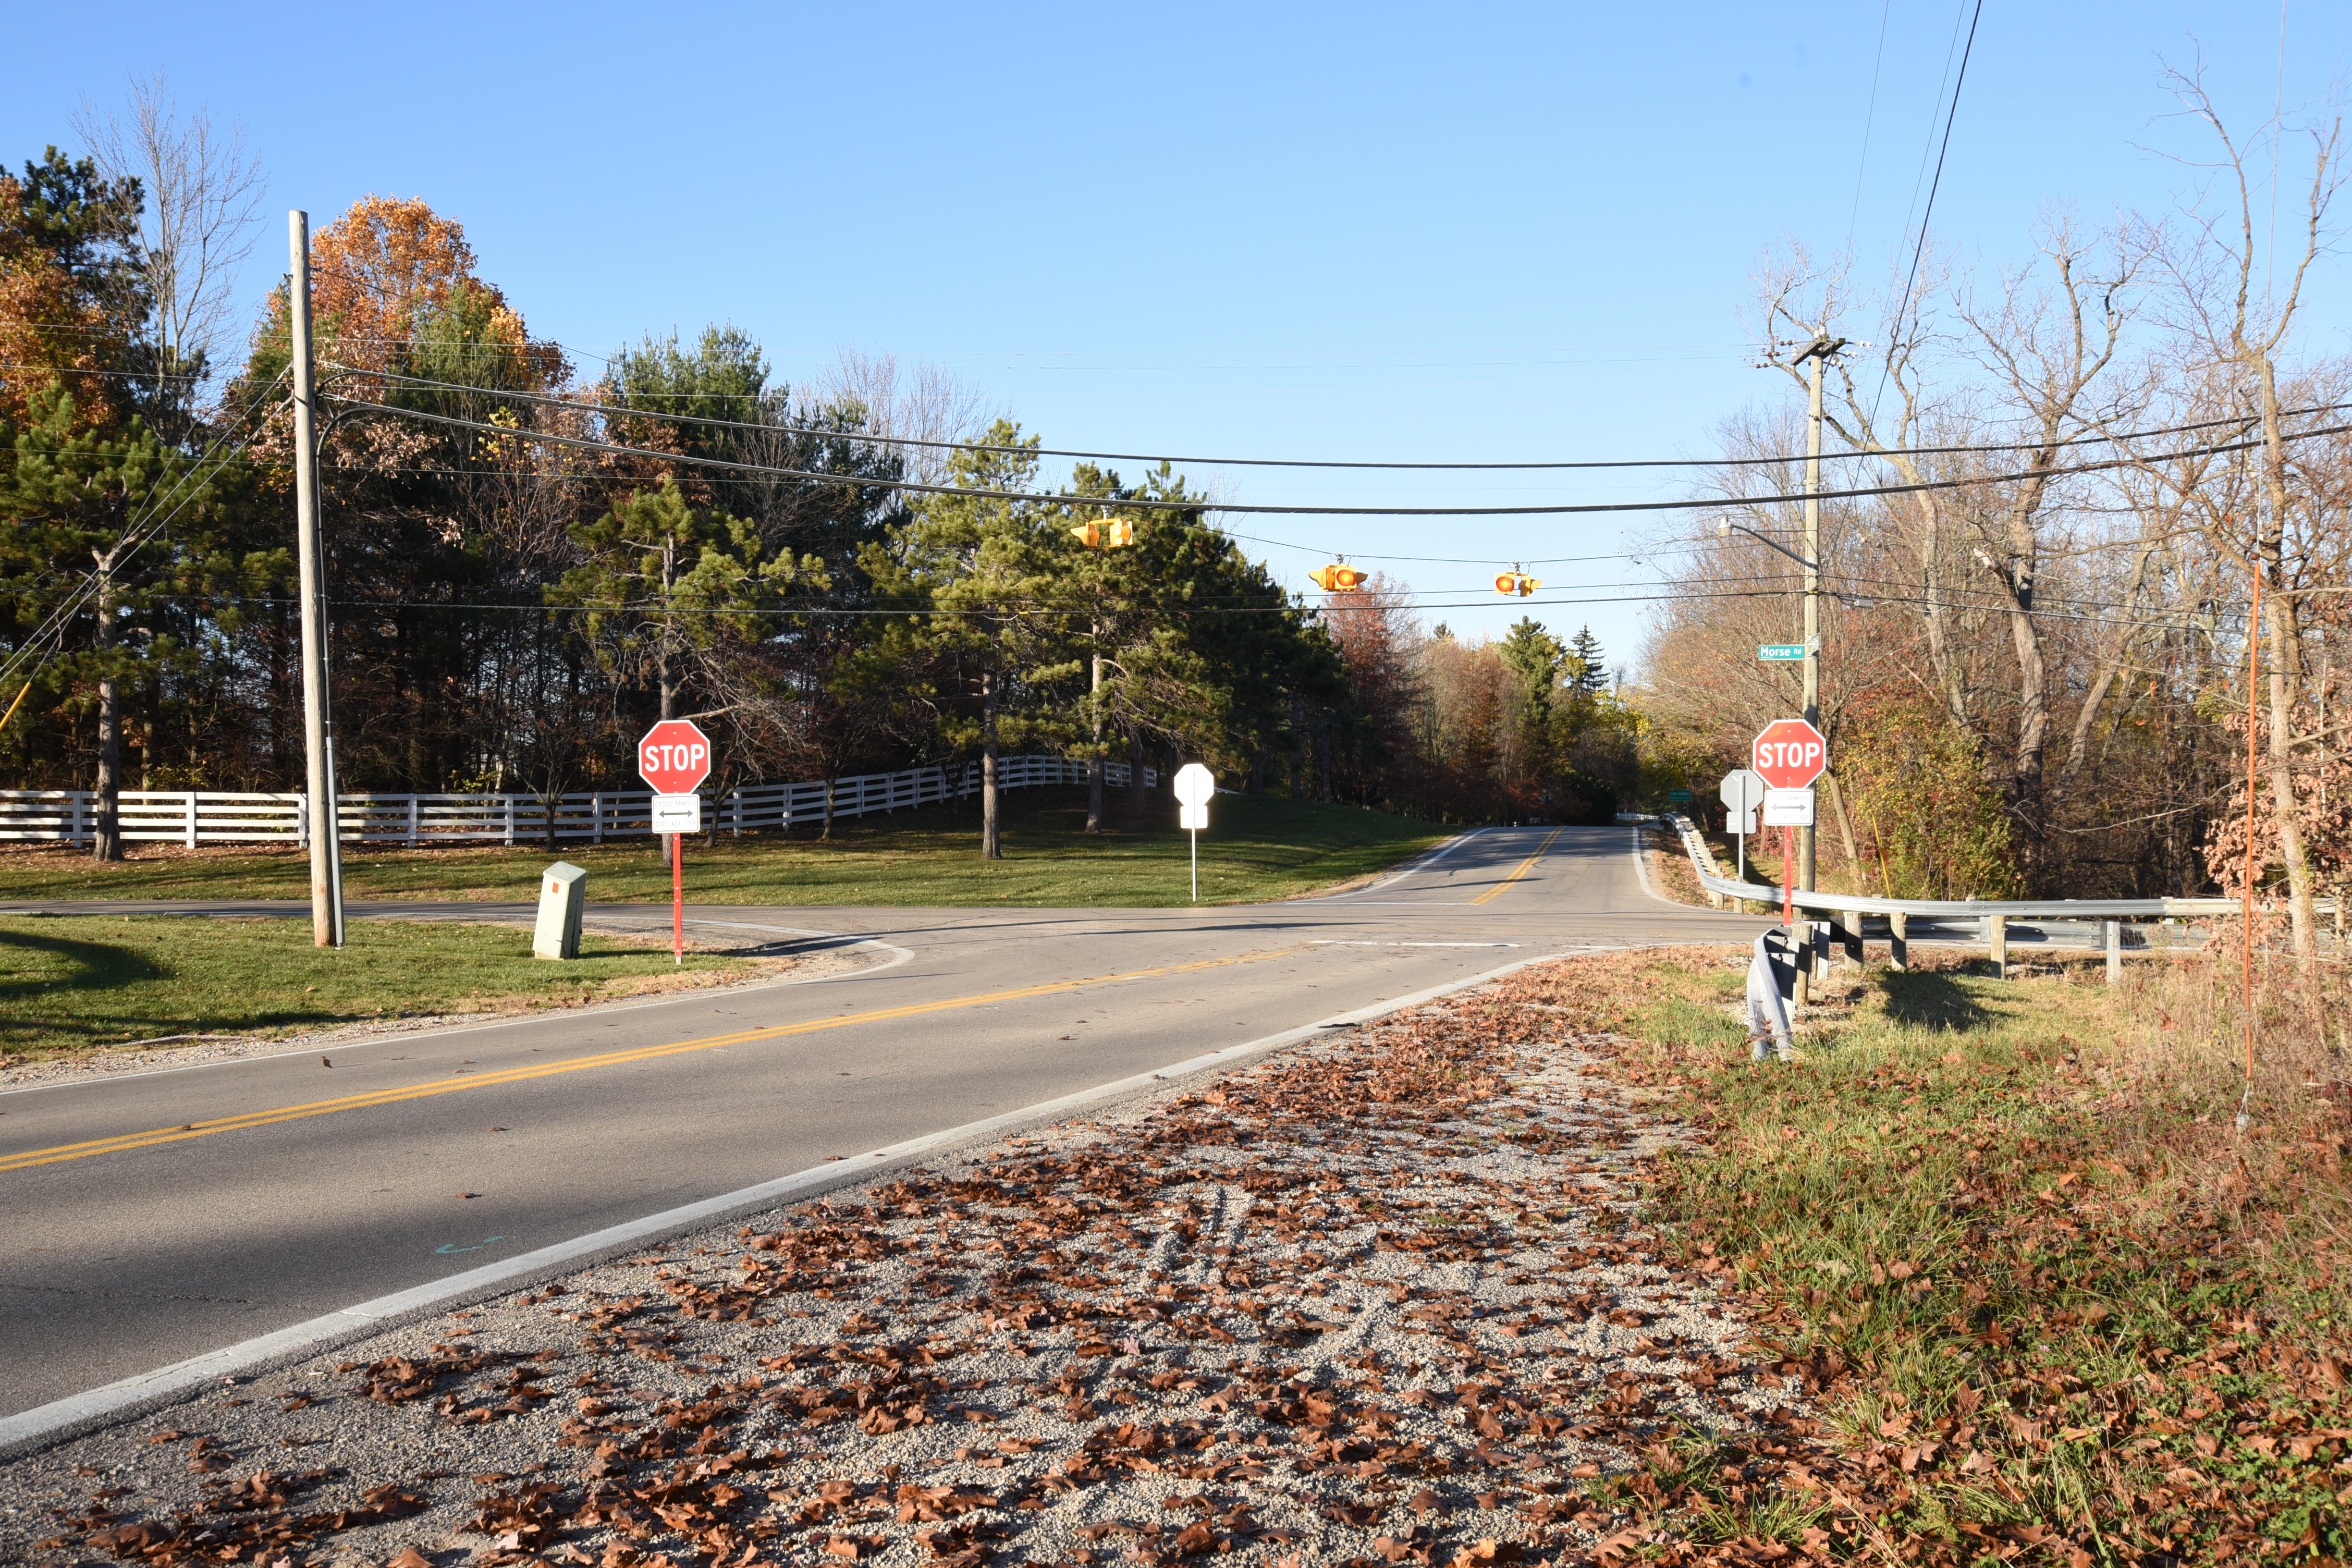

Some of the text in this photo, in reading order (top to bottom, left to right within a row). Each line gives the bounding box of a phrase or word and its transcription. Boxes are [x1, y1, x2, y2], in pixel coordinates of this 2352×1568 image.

[1760, 647, 1791, 656] Morse
[645, 744, 705, 772] STOP
[1759, 742, 1820, 768] STOP
